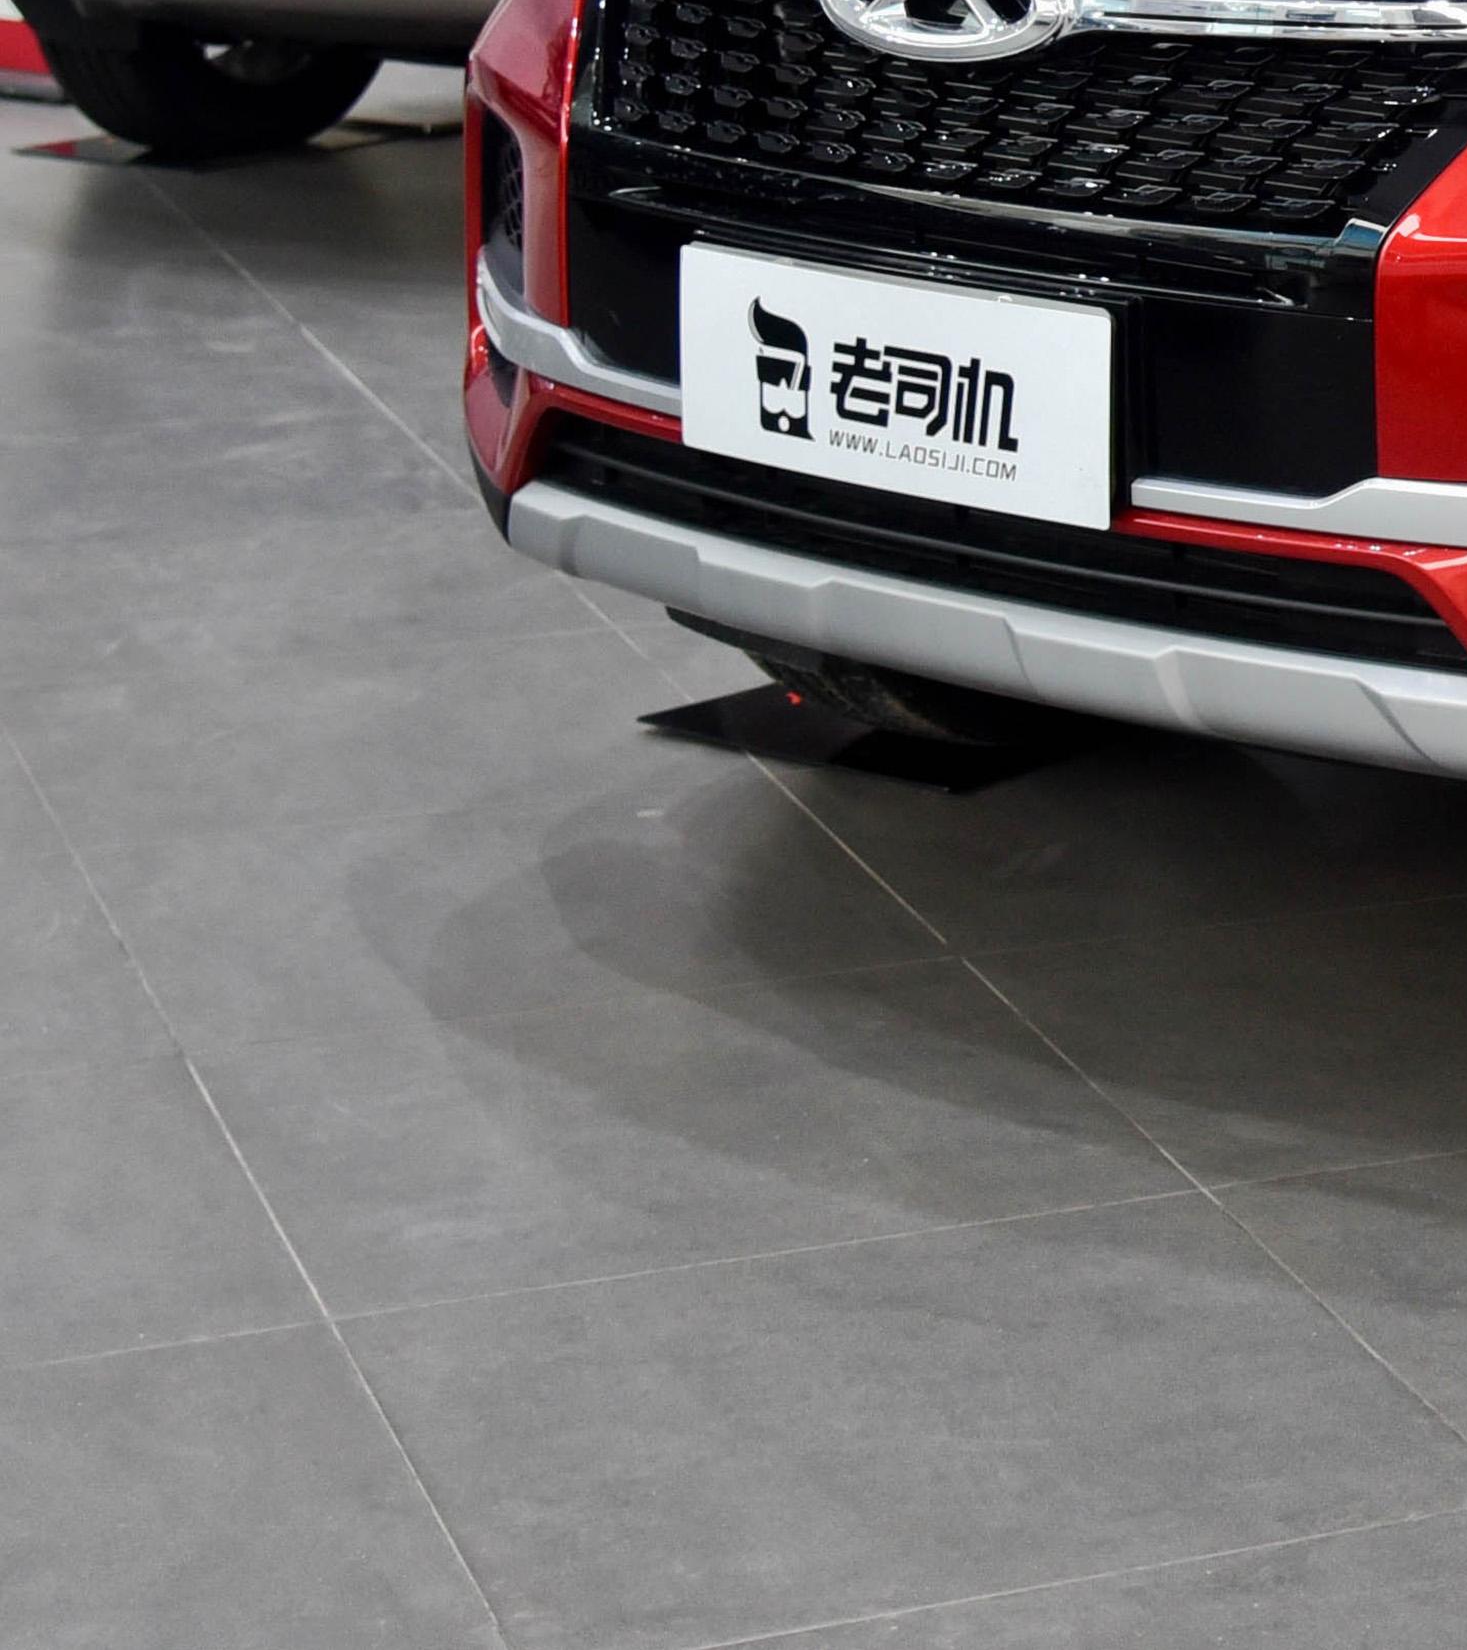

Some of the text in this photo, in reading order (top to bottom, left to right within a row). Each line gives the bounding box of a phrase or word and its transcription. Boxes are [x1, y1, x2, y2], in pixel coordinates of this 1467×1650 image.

[830, 337, 1019, 453] 老司机
[829, 429, 1017, 482] WWW.LAOSIJI.COM
